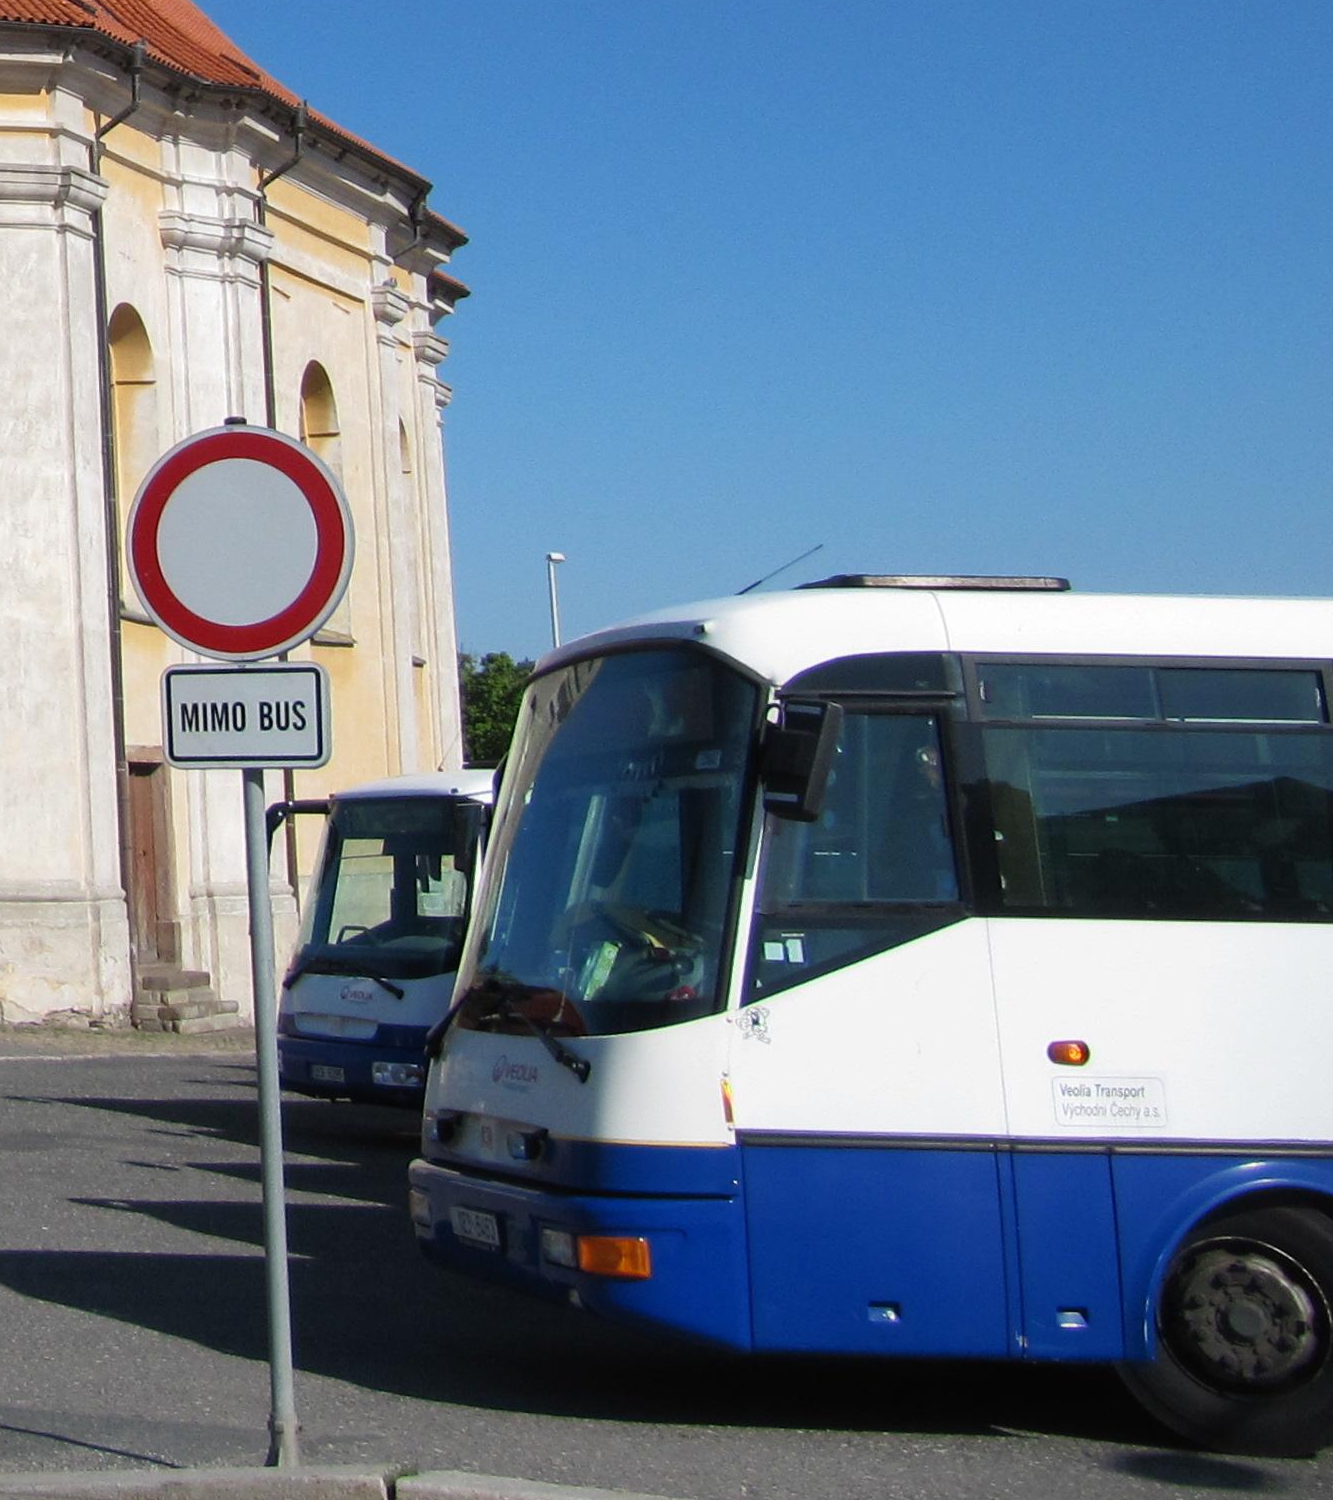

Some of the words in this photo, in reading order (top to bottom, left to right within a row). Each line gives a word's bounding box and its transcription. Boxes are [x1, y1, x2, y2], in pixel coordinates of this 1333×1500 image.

[180, 701, 246, 732] MIMO
[258, 700, 307, 731] BUS
[504, 1063, 539, 1083] VEOLIA
[1060, 1083, 1091, 1098] Veolia
[1094, 1083, 1145, 1100] Transport
